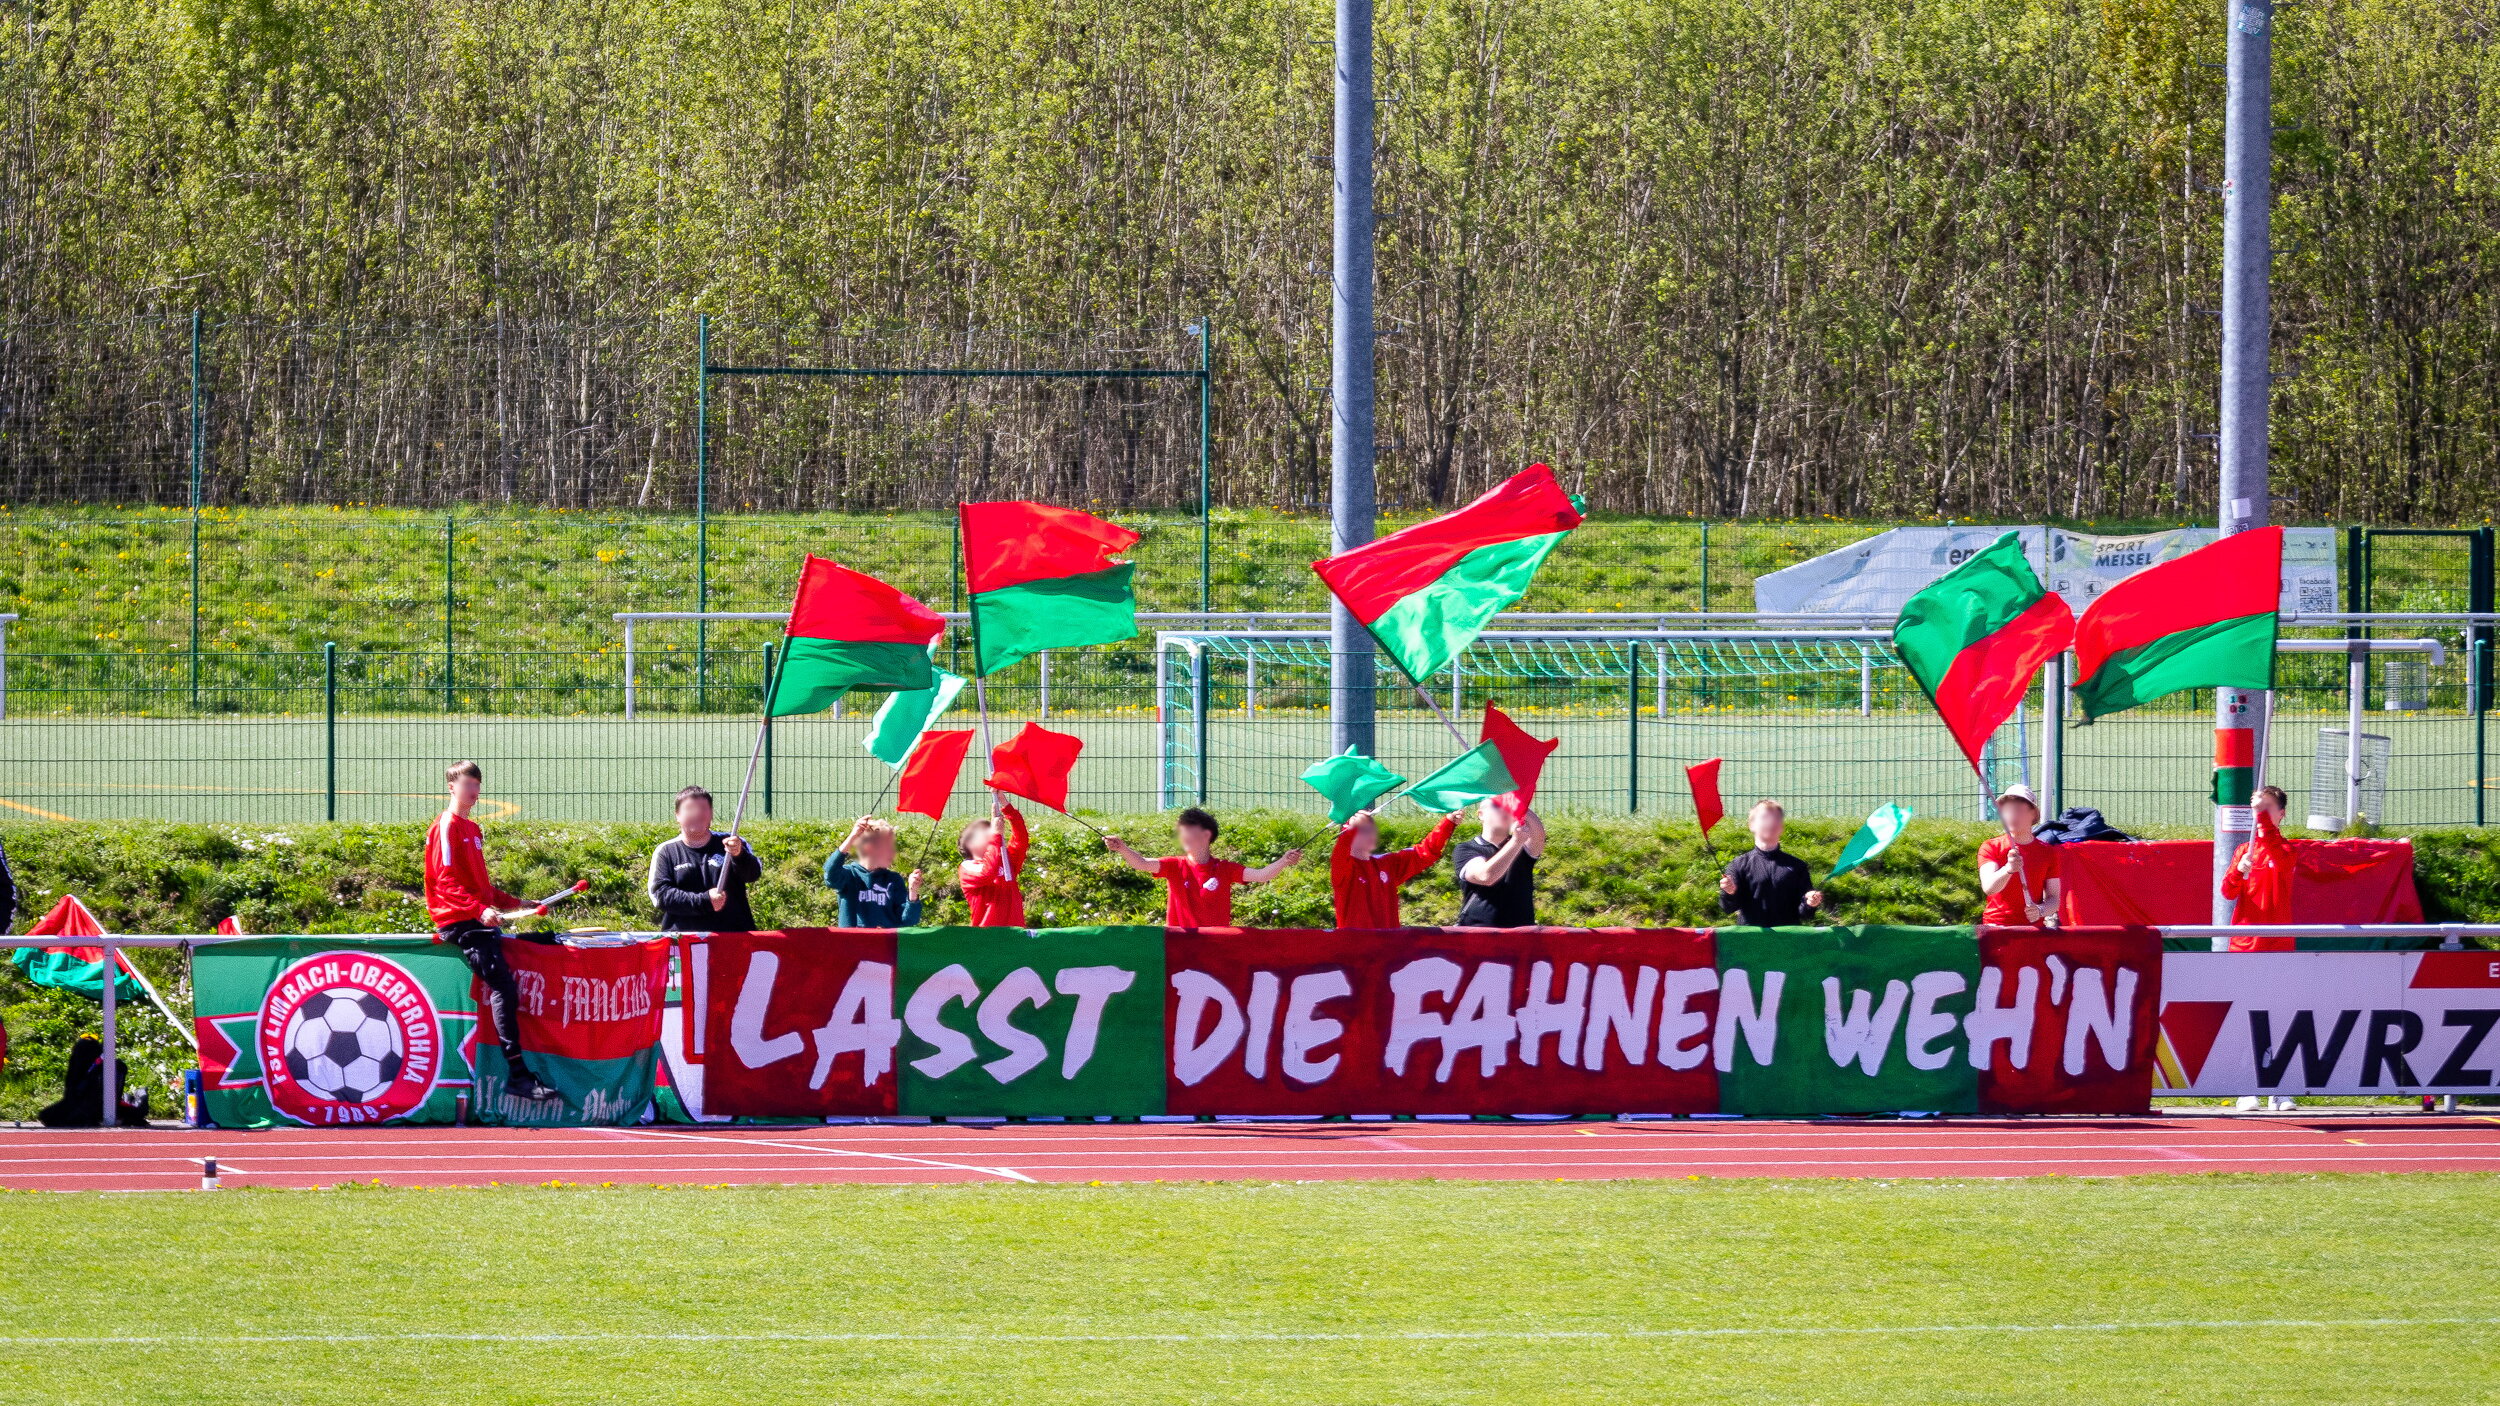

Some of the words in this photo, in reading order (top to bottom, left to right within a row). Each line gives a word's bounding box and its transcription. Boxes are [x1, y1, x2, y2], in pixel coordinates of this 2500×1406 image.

[2095, 552, 2152, 566] MEISEL
[2097, 540, 2145, 552] SPORT
[264, 961, 432, 1084] LIMBACH-OBERFROHNA
[730, 950, 1136, 1090] LASST
[1171, 969, 1352, 1087] DIE
[1385, 956, 1786, 1083] FAHNEN
[1822, 954, 2138, 1077] WEH'N
[2249, 1009, 2500, 1088] WRZ
